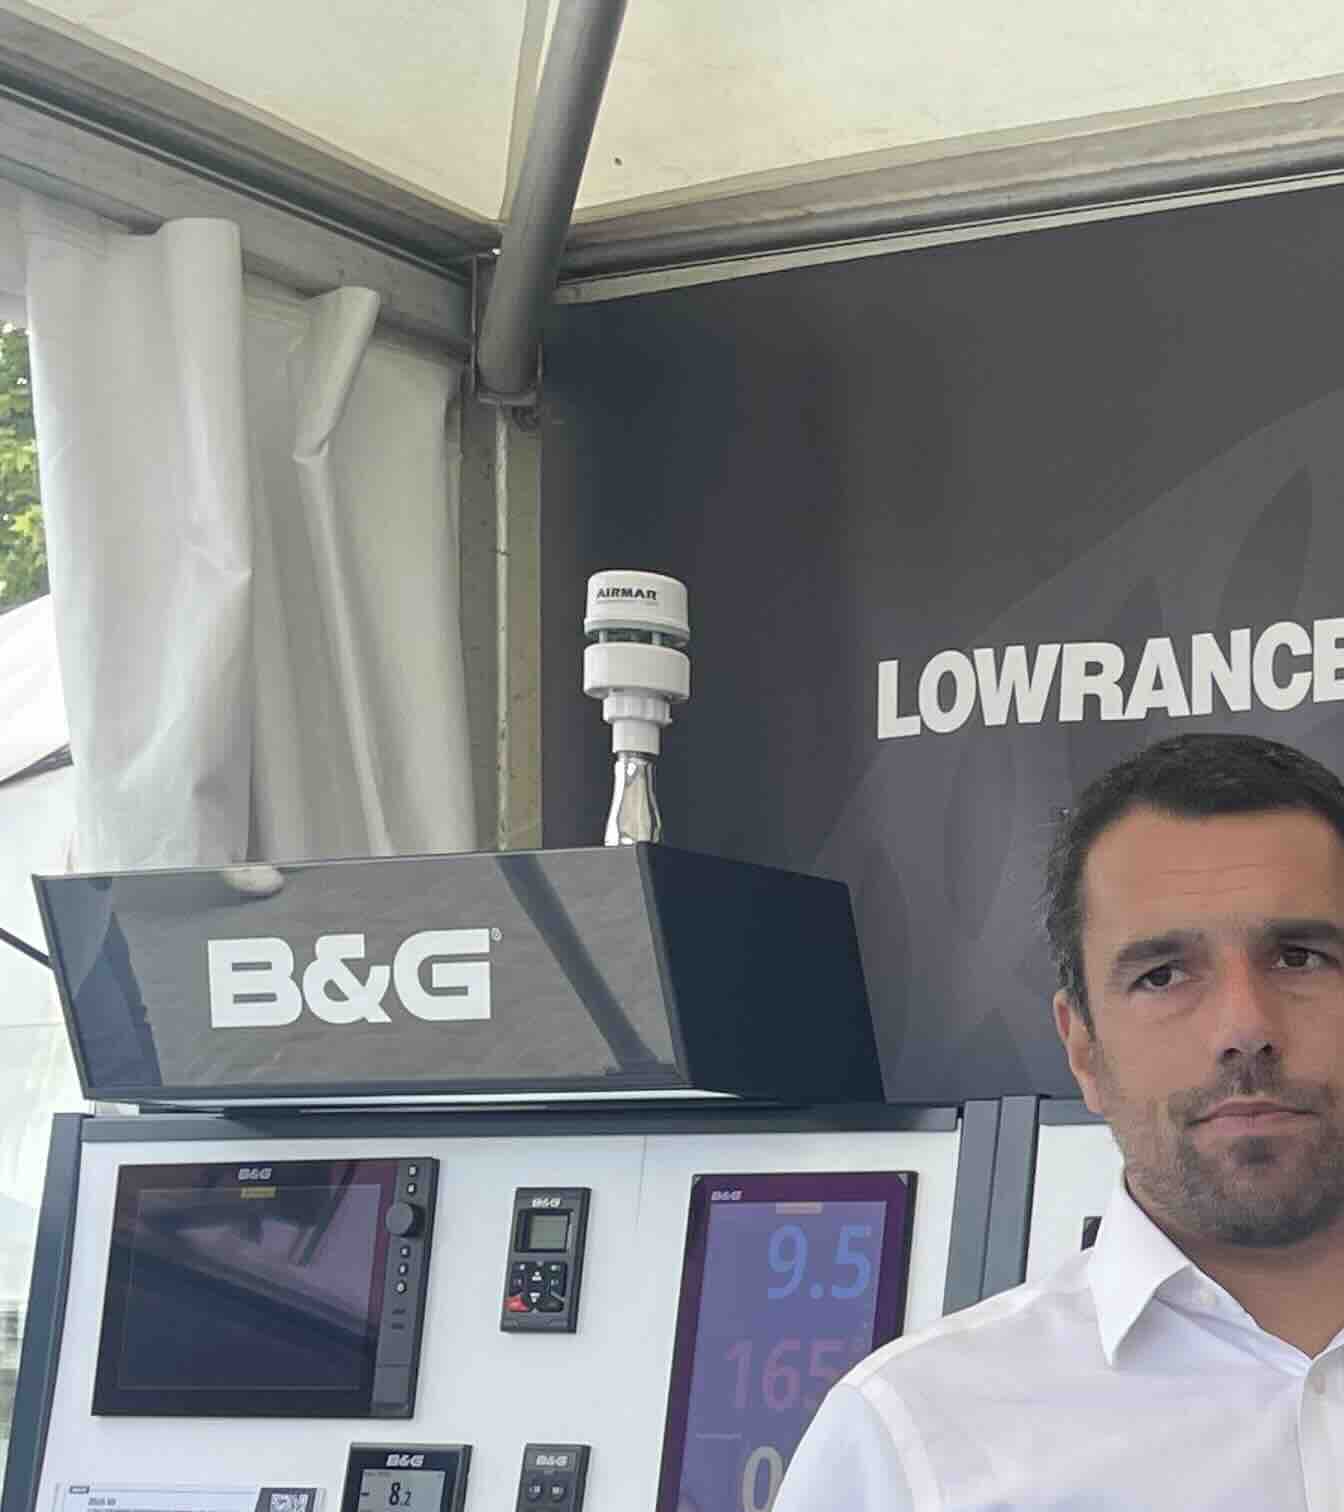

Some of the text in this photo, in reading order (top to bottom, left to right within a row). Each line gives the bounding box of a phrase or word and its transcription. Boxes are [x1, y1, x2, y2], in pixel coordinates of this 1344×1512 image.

[596, 587, 657, 600] AIRMAR
[207, 928, 491, 1029] B&G
[767, 1223, 872, 1300] 9.5
